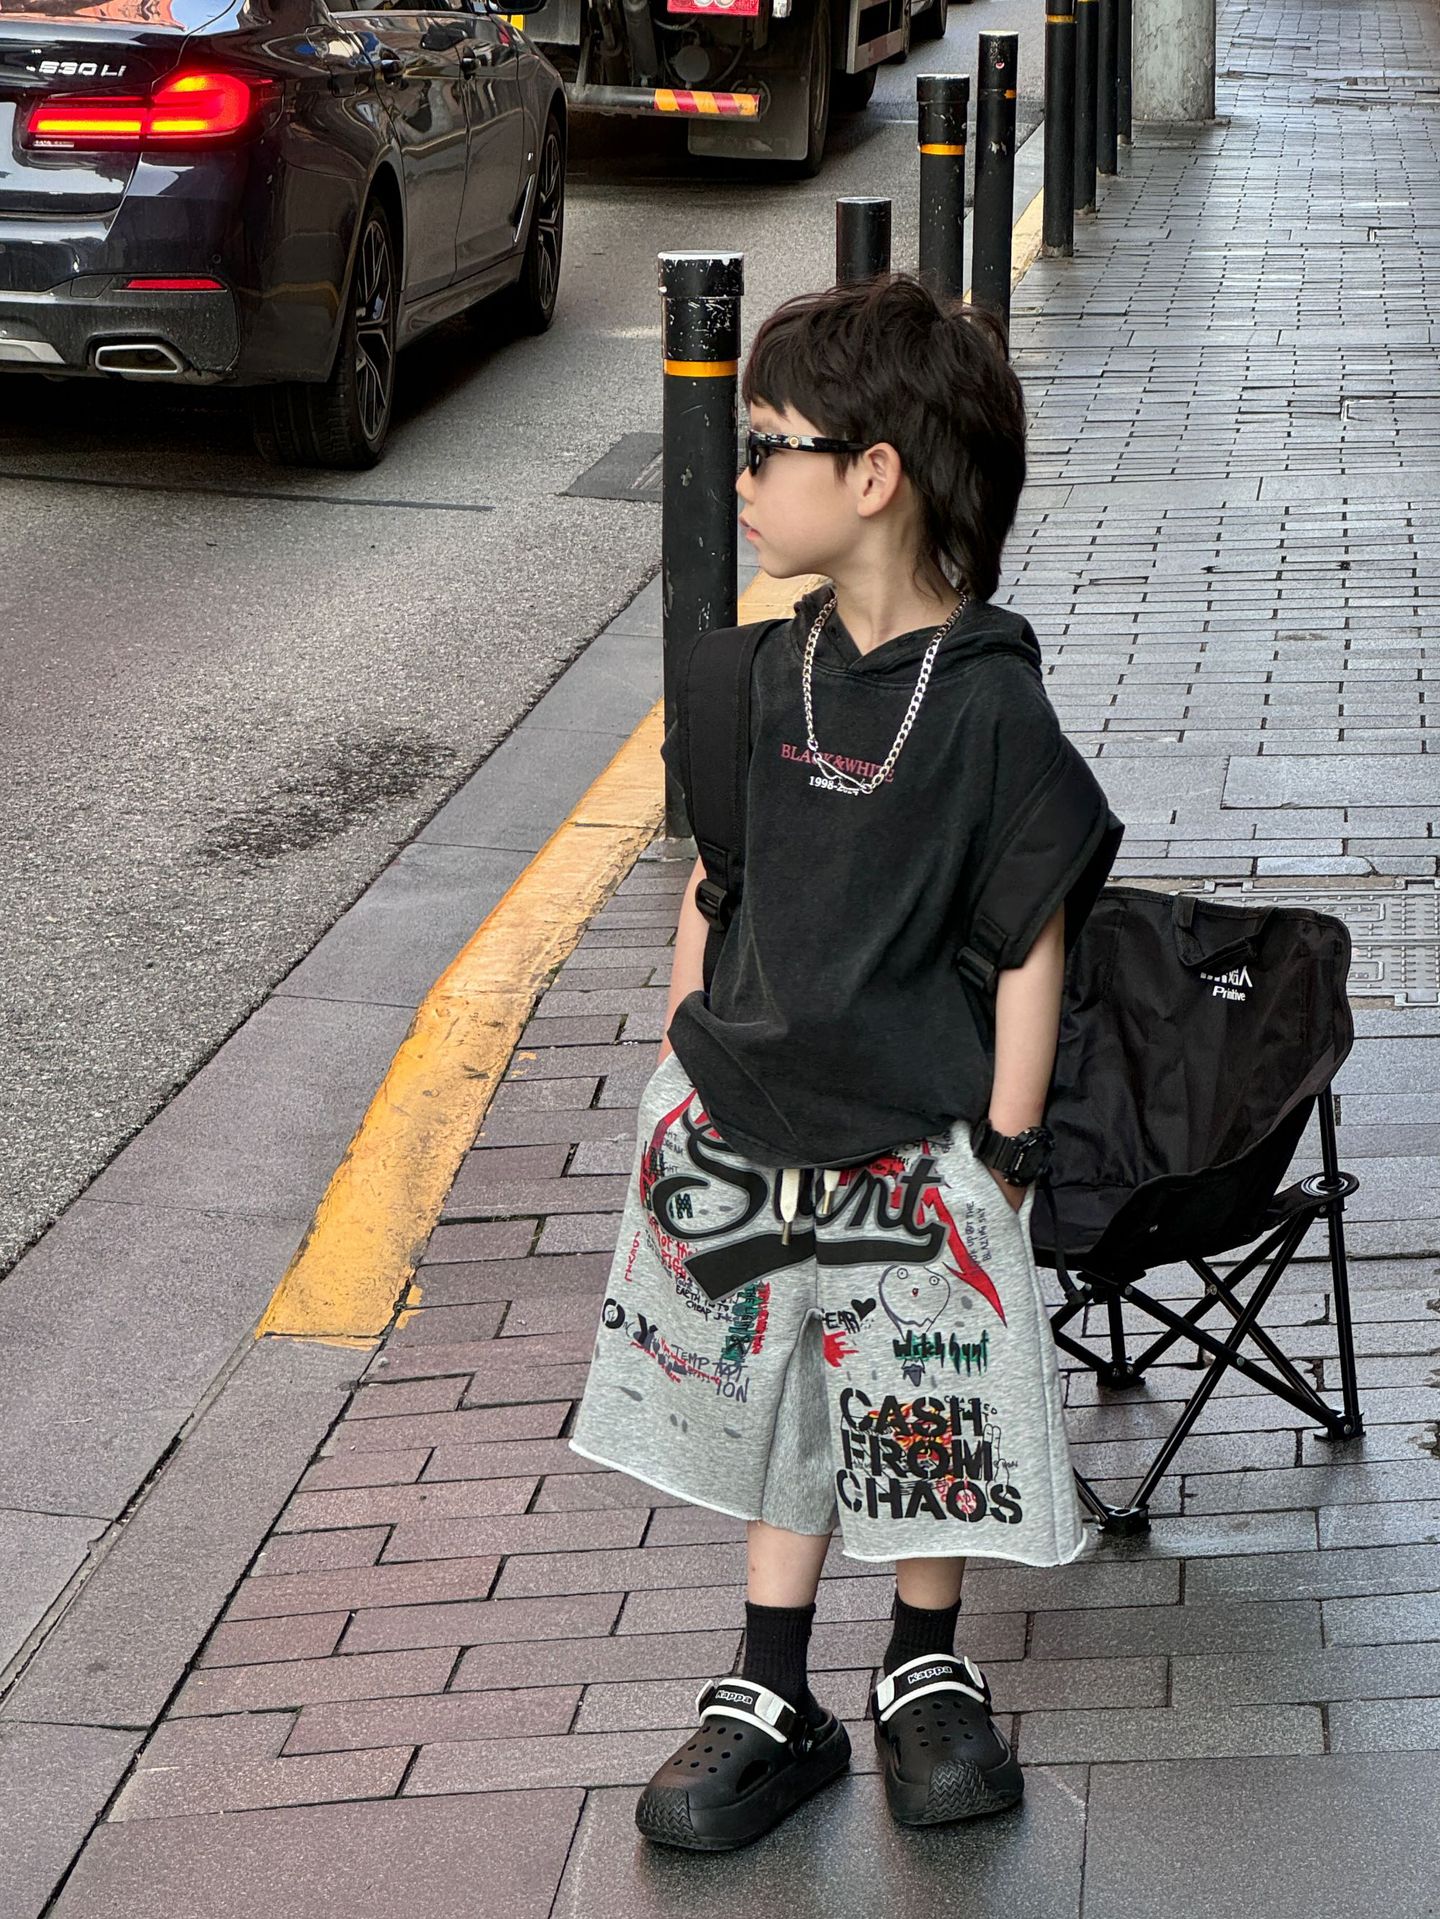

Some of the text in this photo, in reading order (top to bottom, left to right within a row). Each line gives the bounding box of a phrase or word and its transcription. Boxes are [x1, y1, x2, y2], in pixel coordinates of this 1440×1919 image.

[840, 1387, 983, 1436] CASH
[842, 1429, 993, 1480] FROM
[836, 1469, 1023, 1524] CHAOS
[907, 1665, 953, 1685] Kappa
